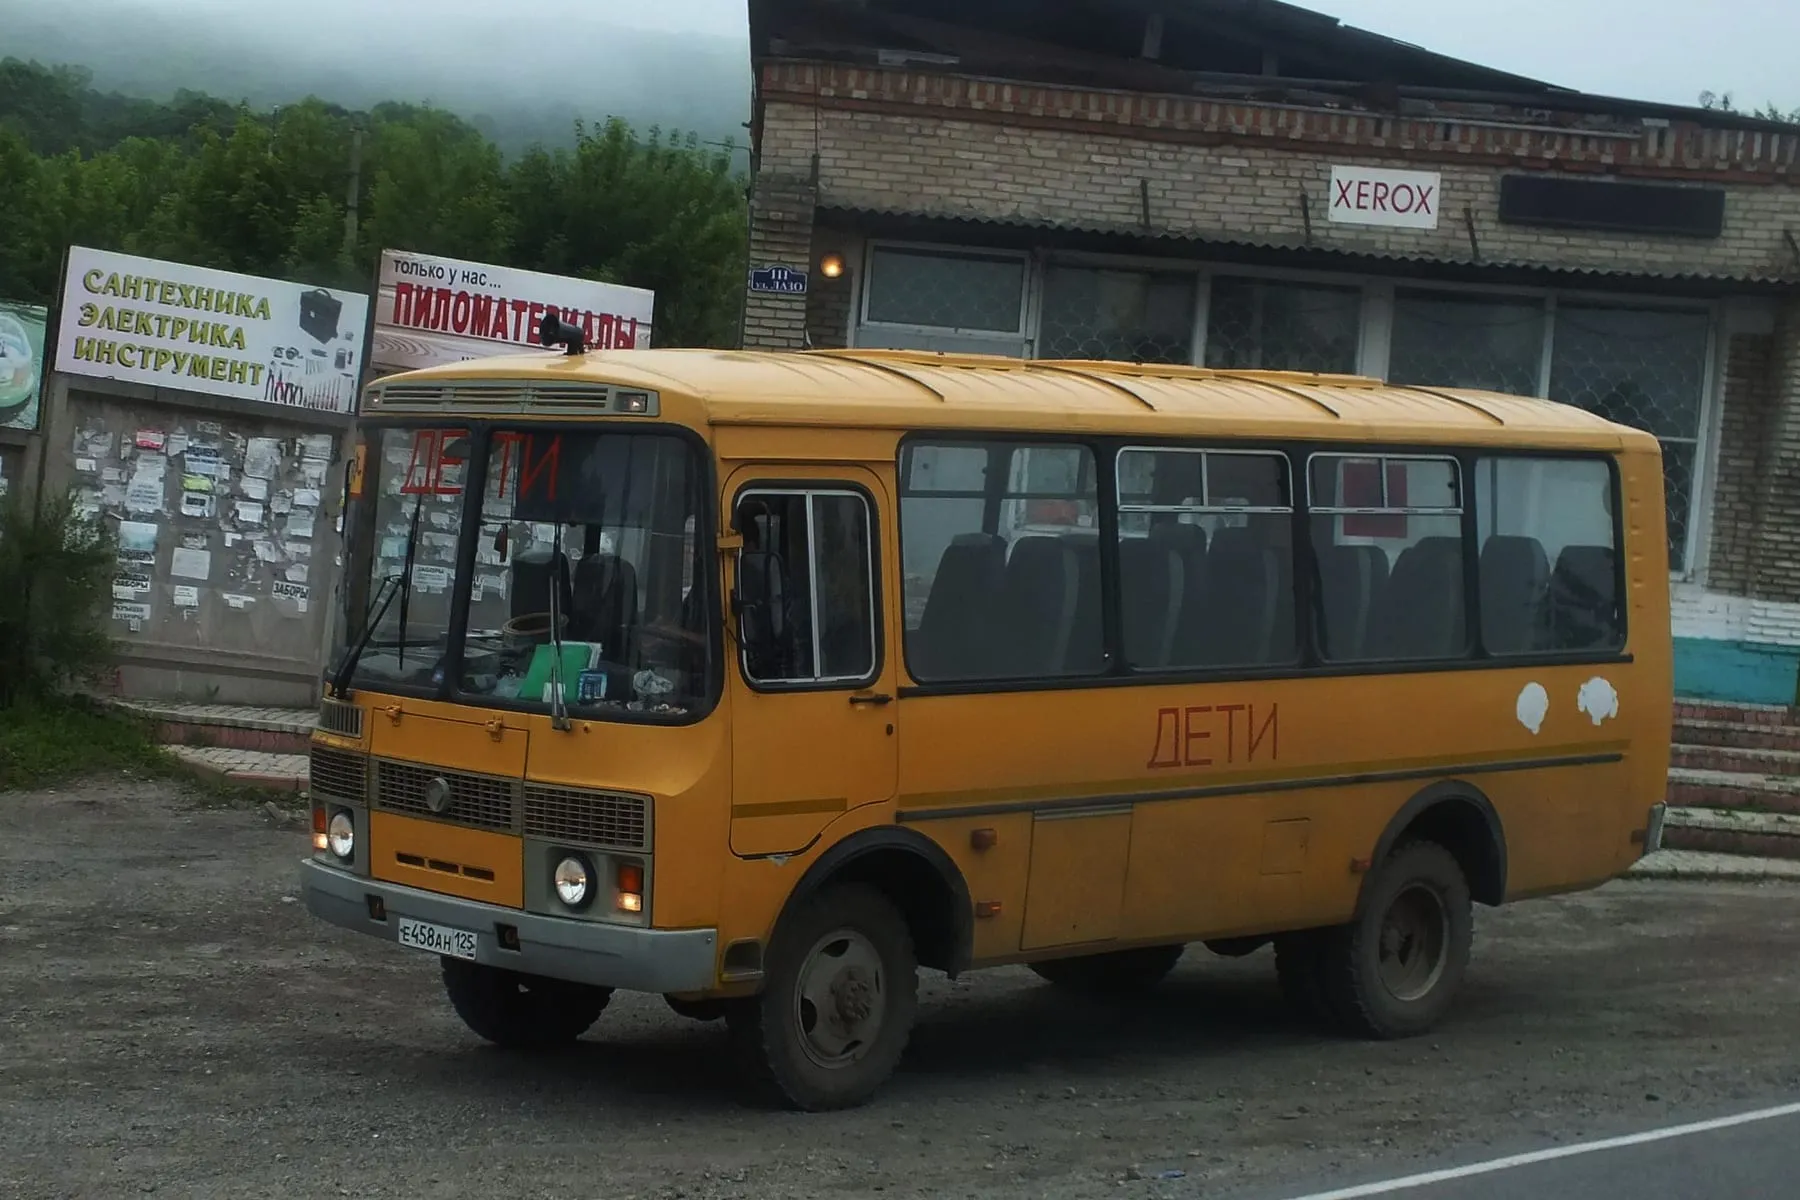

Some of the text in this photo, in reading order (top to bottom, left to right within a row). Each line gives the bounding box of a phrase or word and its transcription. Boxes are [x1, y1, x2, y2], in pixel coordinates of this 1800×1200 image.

[1334, 179, 1433, 214] XEROX
[83, 268, 272, 320] САНТЕХНИКА
[393, 260, 445, 279] только
[448, 268, 457, 285] у
[78, 302, 247, 351] ЭЛЕКТРИКА
[73, 335, 266, 386] ИНСТРУМЕНТ
[273, 582, 309, 599] ЗАБОРЫ
[1147, 702, 1278, 769] ДЕТИ
